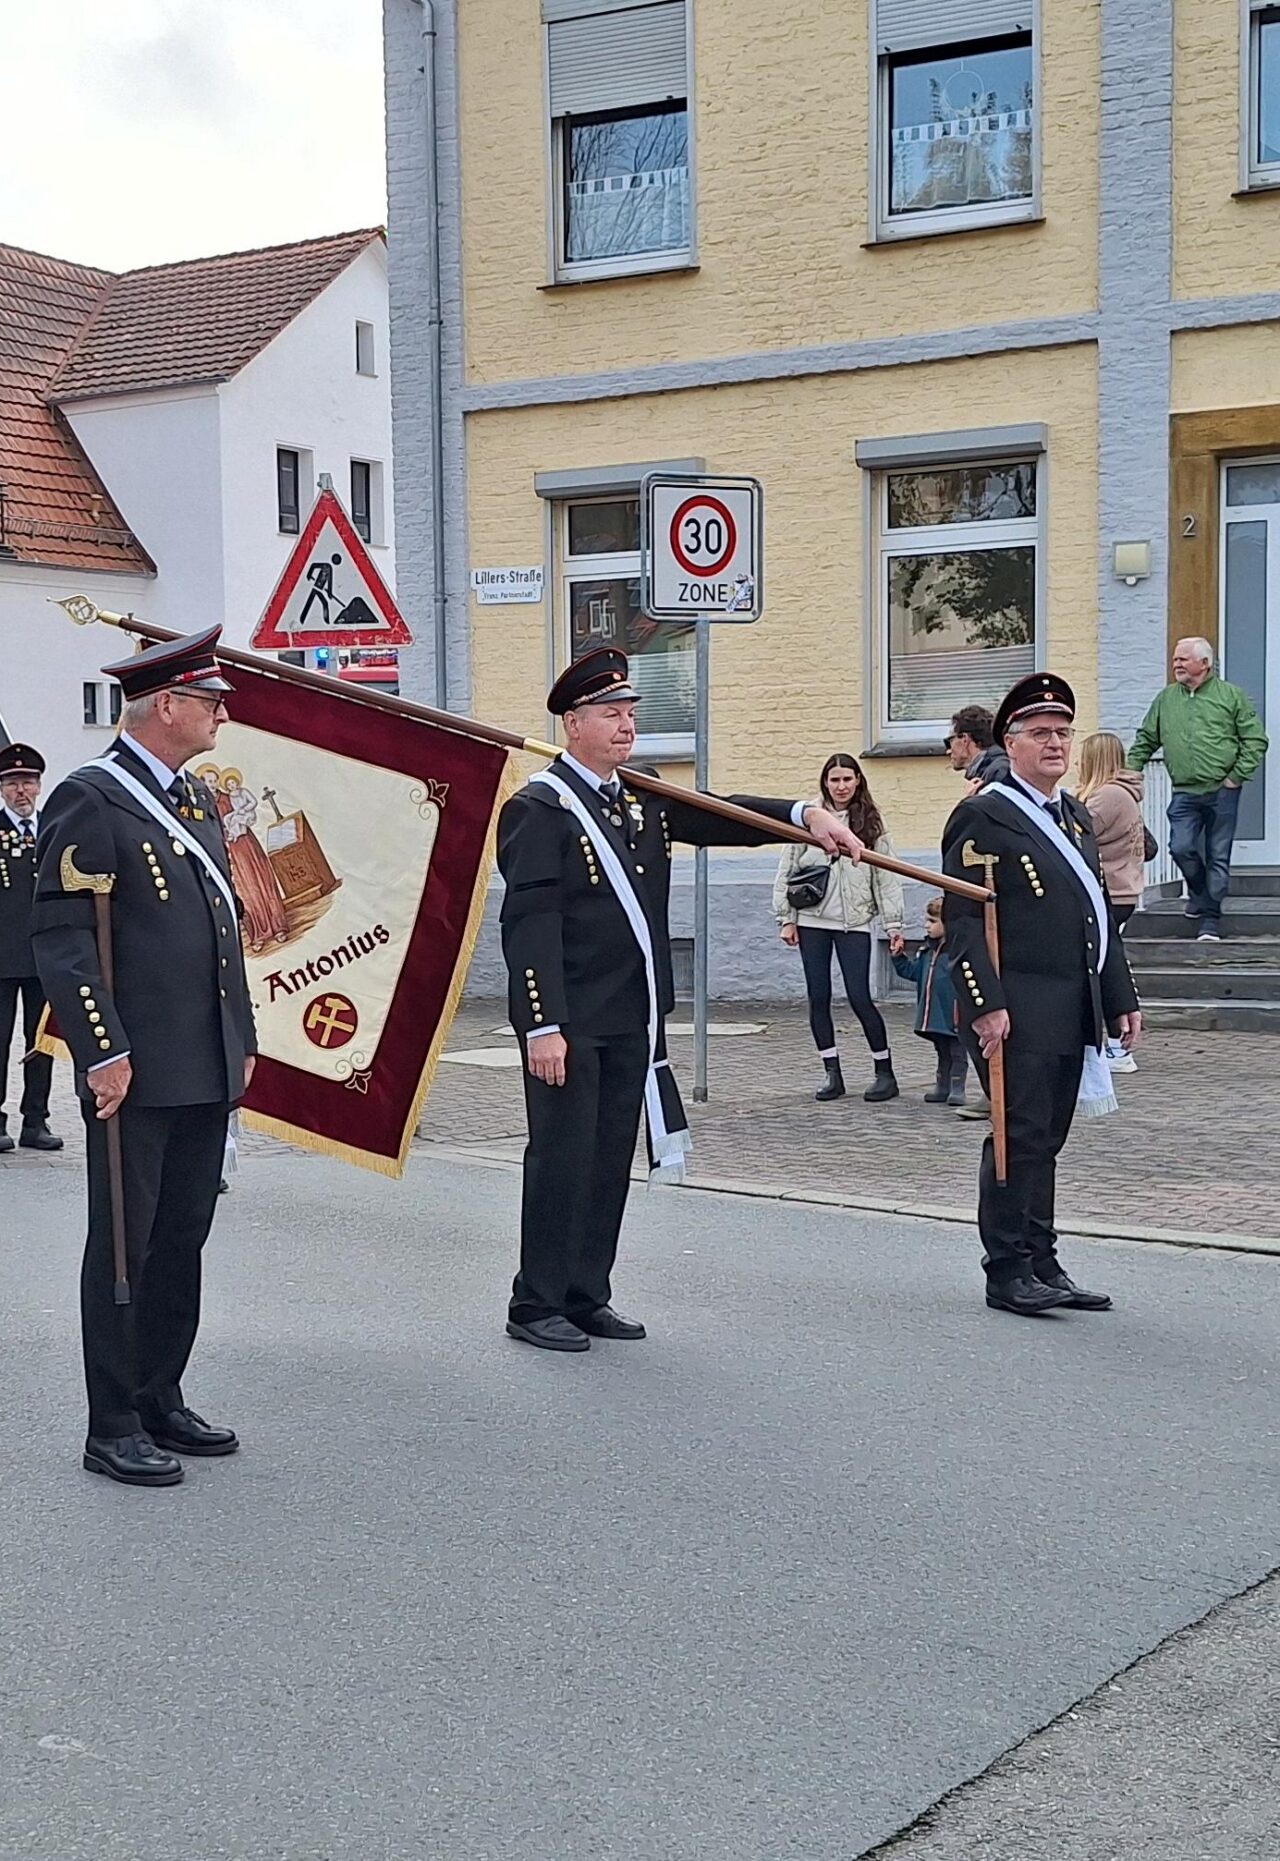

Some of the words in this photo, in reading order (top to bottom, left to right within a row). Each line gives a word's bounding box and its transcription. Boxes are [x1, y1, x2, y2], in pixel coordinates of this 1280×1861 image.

[683, 517, 722, 555] 30
[1182, 514, 1196, 537] 2
[475, 569, 542, 585] Lillers-Straße
[678, 583, 728, 602] ZONE
[262, 924, 390, 1003] Antonius
